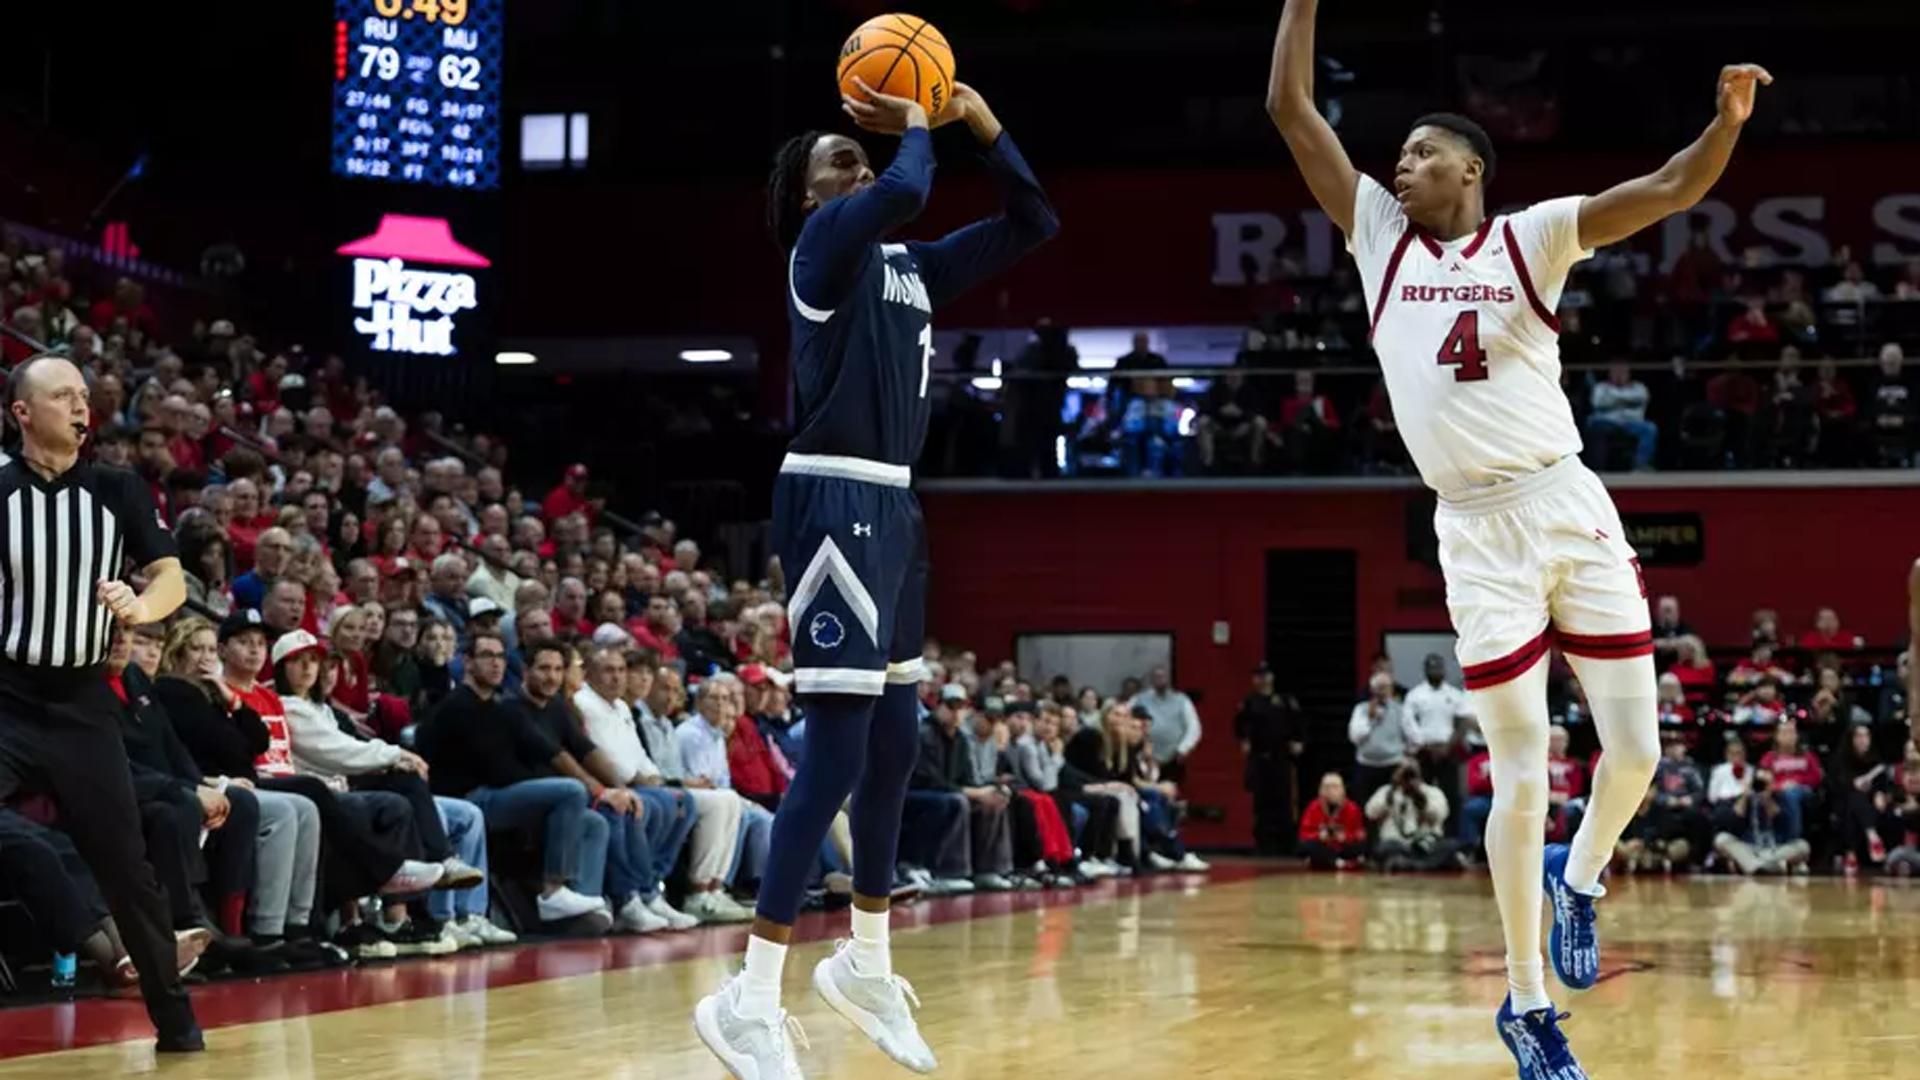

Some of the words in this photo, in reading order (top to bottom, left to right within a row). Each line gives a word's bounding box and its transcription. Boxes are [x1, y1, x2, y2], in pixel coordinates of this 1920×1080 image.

[364, 16, 398, 41] RU
[443, 27, 478, 51] MU
[358, 45, 400, 81] 79
[438, 54, 481, 91] 62
[353, 256, 478, 315] Pizza
[1400, 285, 1515, 303] RUTGERS
[353, 300, 457, 356] Hut
[1437, 309, 1489, 383] 4
